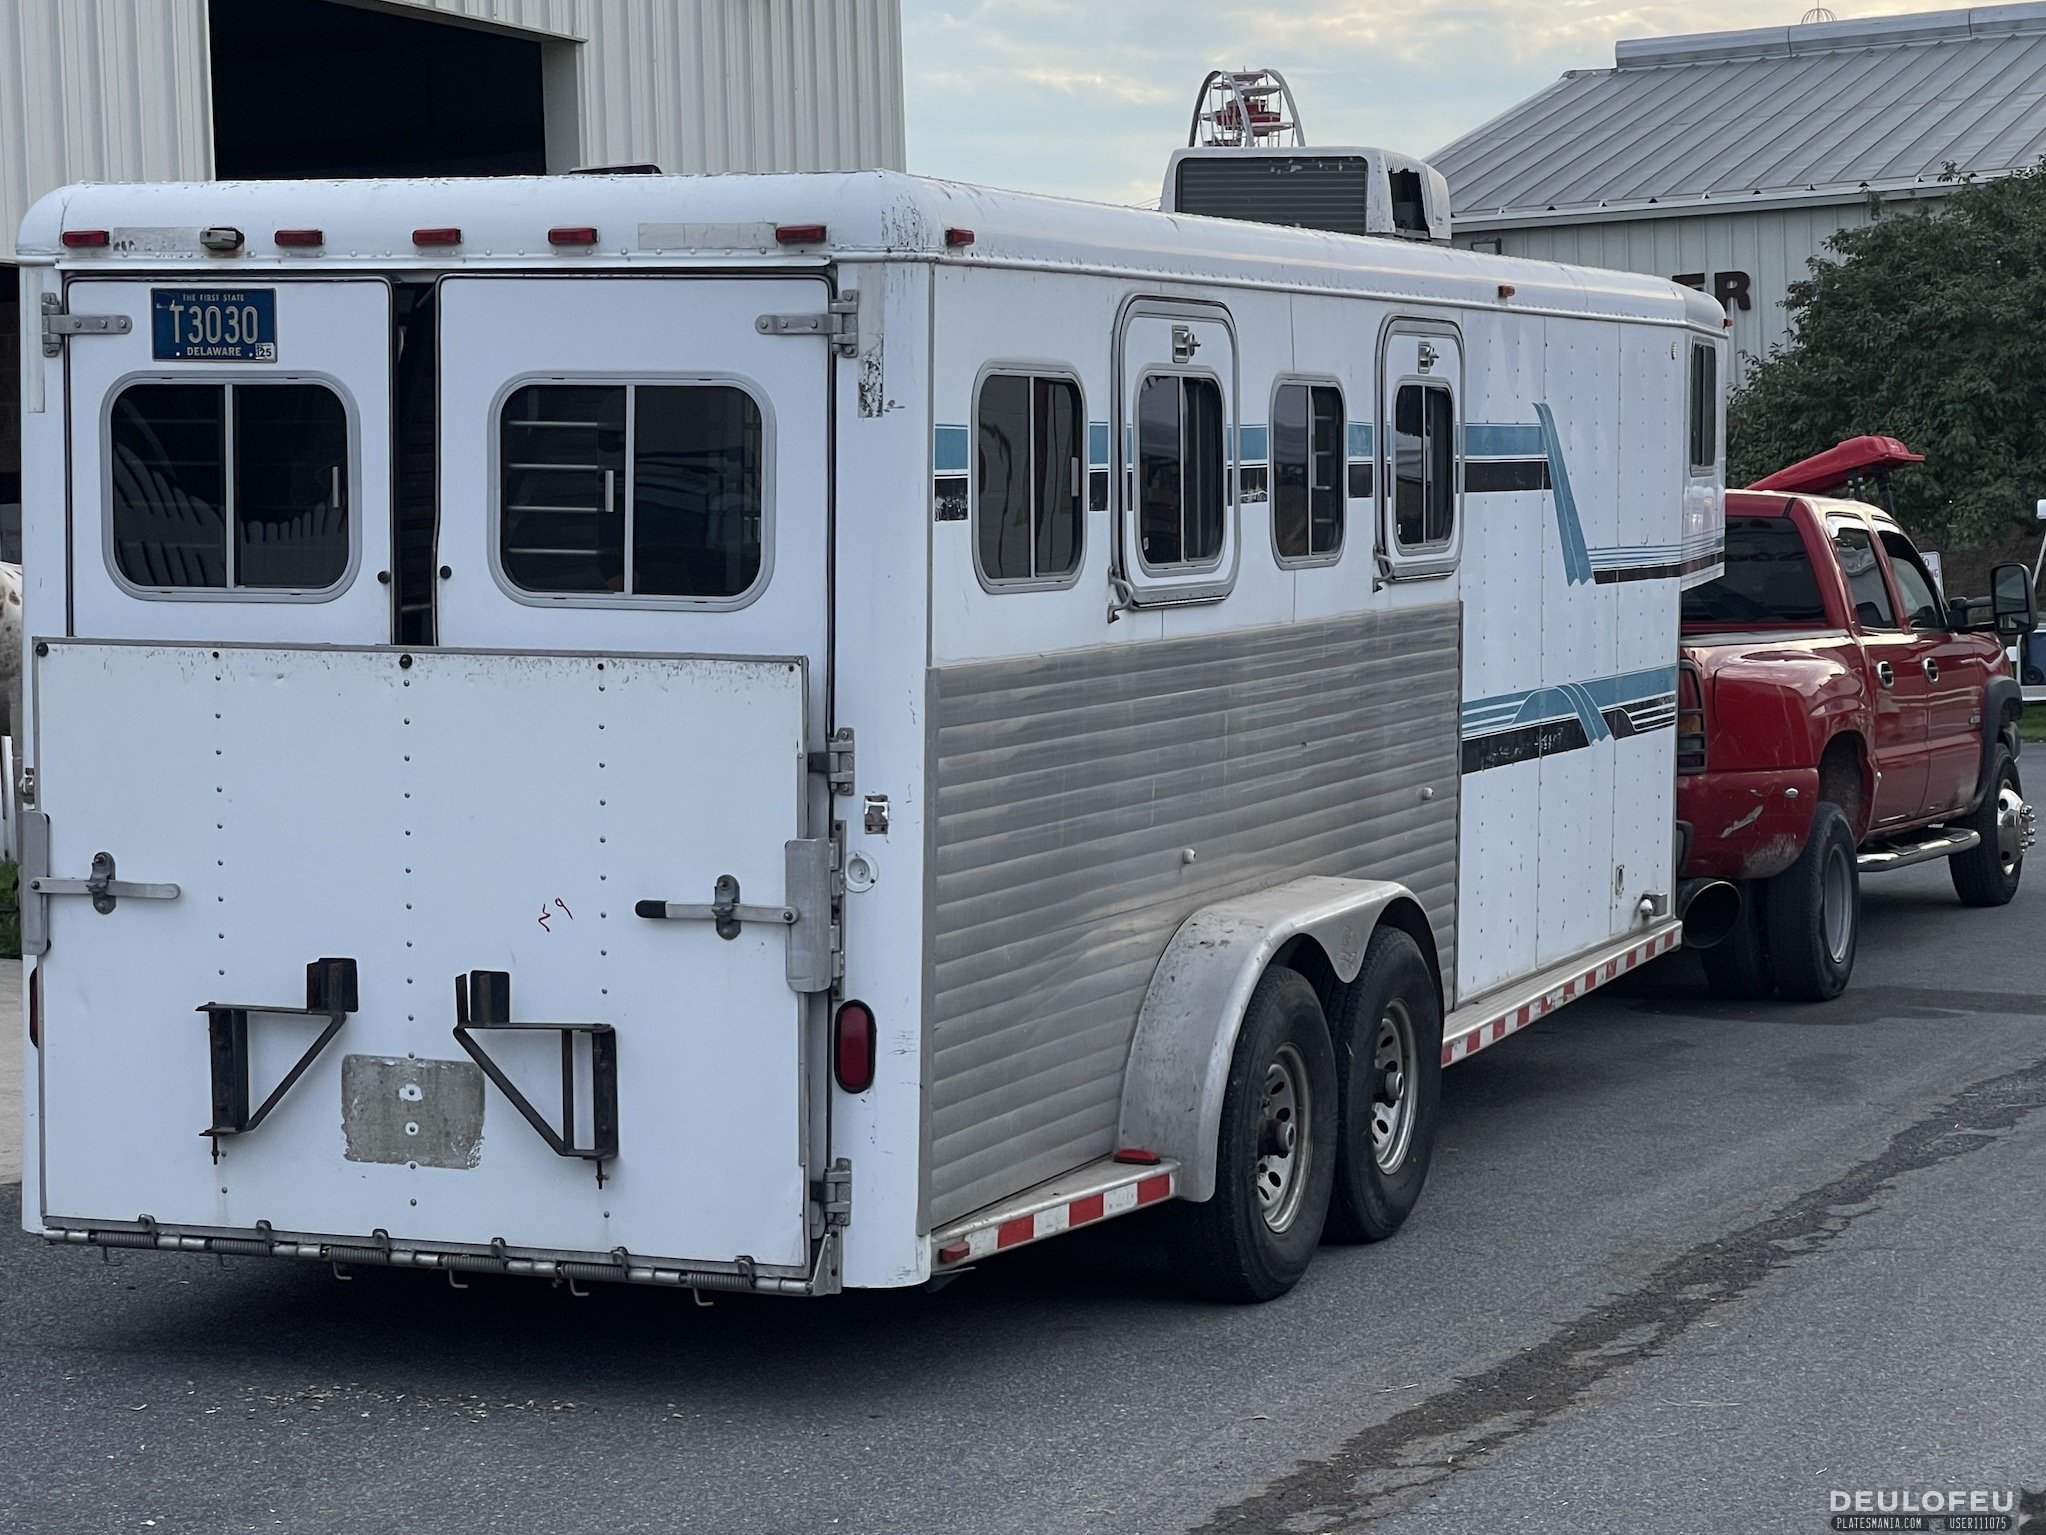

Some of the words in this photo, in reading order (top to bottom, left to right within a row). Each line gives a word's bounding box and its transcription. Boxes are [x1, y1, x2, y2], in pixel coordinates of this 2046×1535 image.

[169, 305, 258, 344] T3030
[187, 347, 241, 356] DELAWARE
[259, 347, 272, 357] 25
